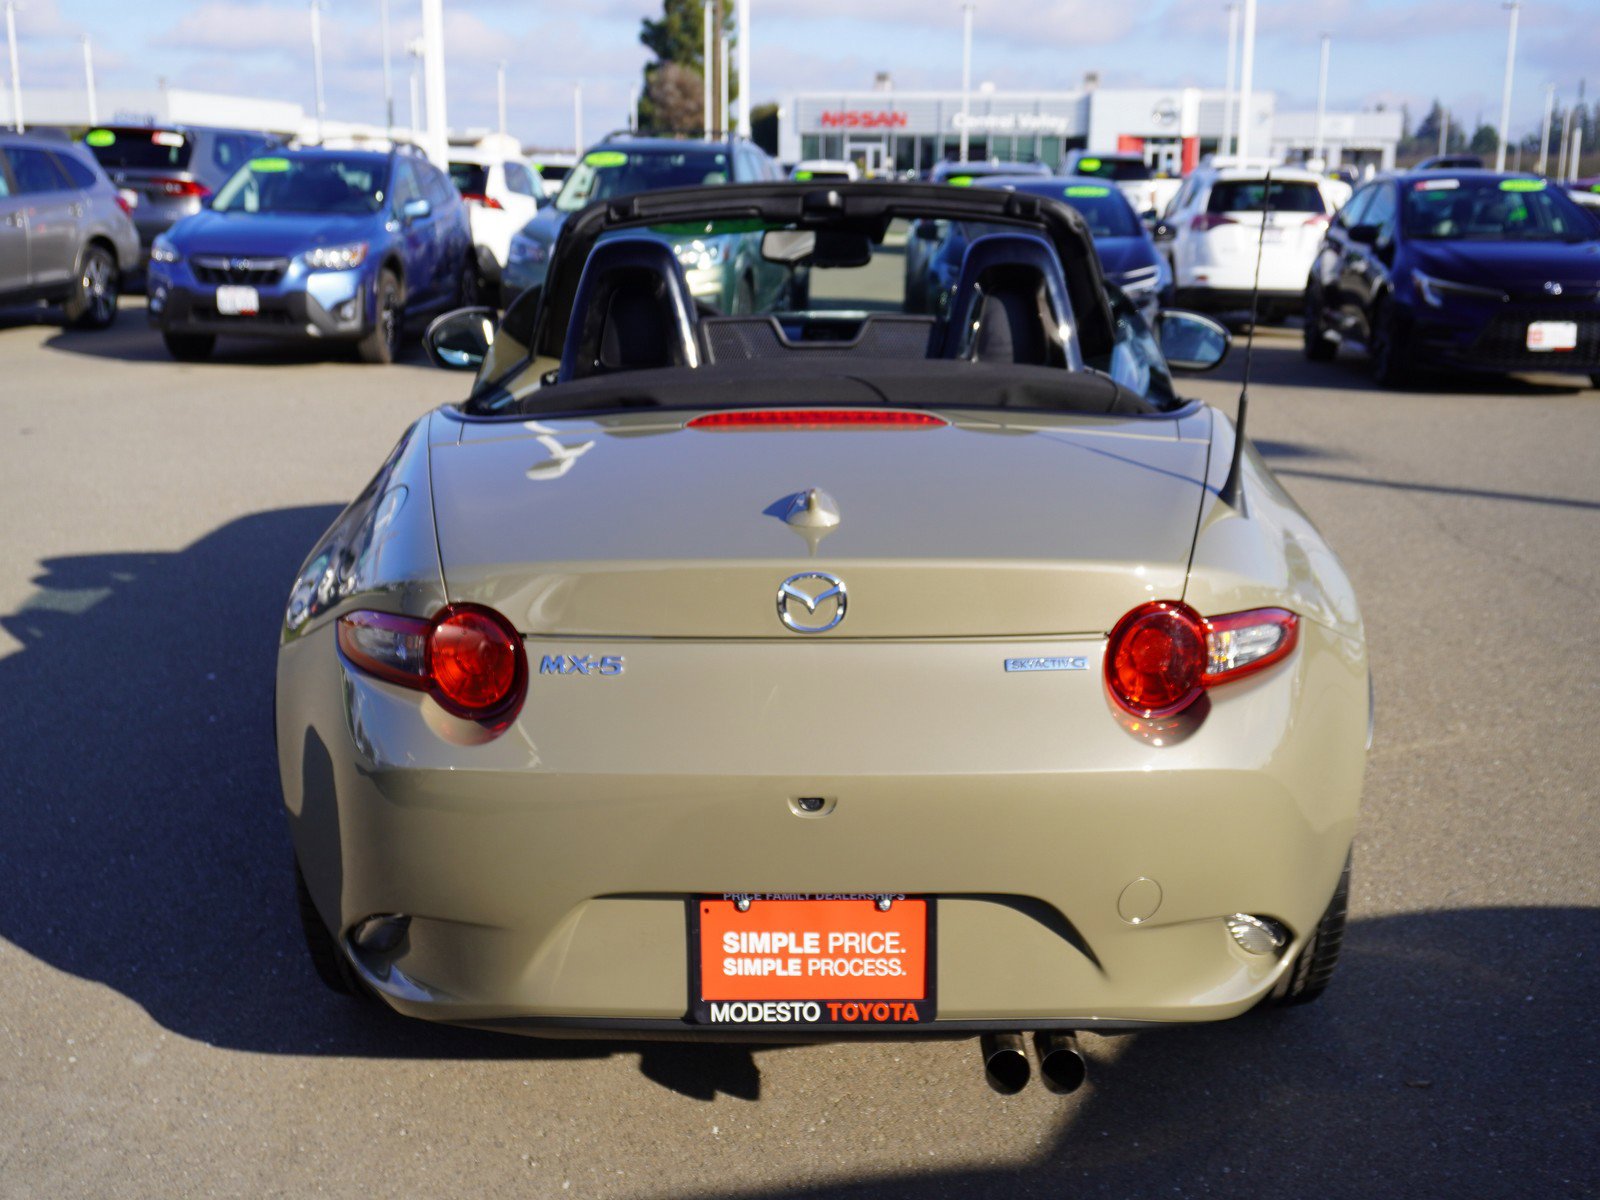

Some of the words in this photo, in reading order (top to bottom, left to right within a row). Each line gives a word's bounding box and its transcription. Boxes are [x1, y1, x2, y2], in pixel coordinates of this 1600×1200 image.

[820, 110, 907, 128] NISSAN
[540, 655, 624, 675] MX-5
[722, 931, 821, 954] SIMPLE
[827, 931, 907, 954] PRICE.
[722, 958, 802, 976] SIMPLE
[807, 958, 907, 977] PROCESS.
[710, 1002, 821, 1023] MODESTO
[826, 1002, 919, 1022] TOYOTA
